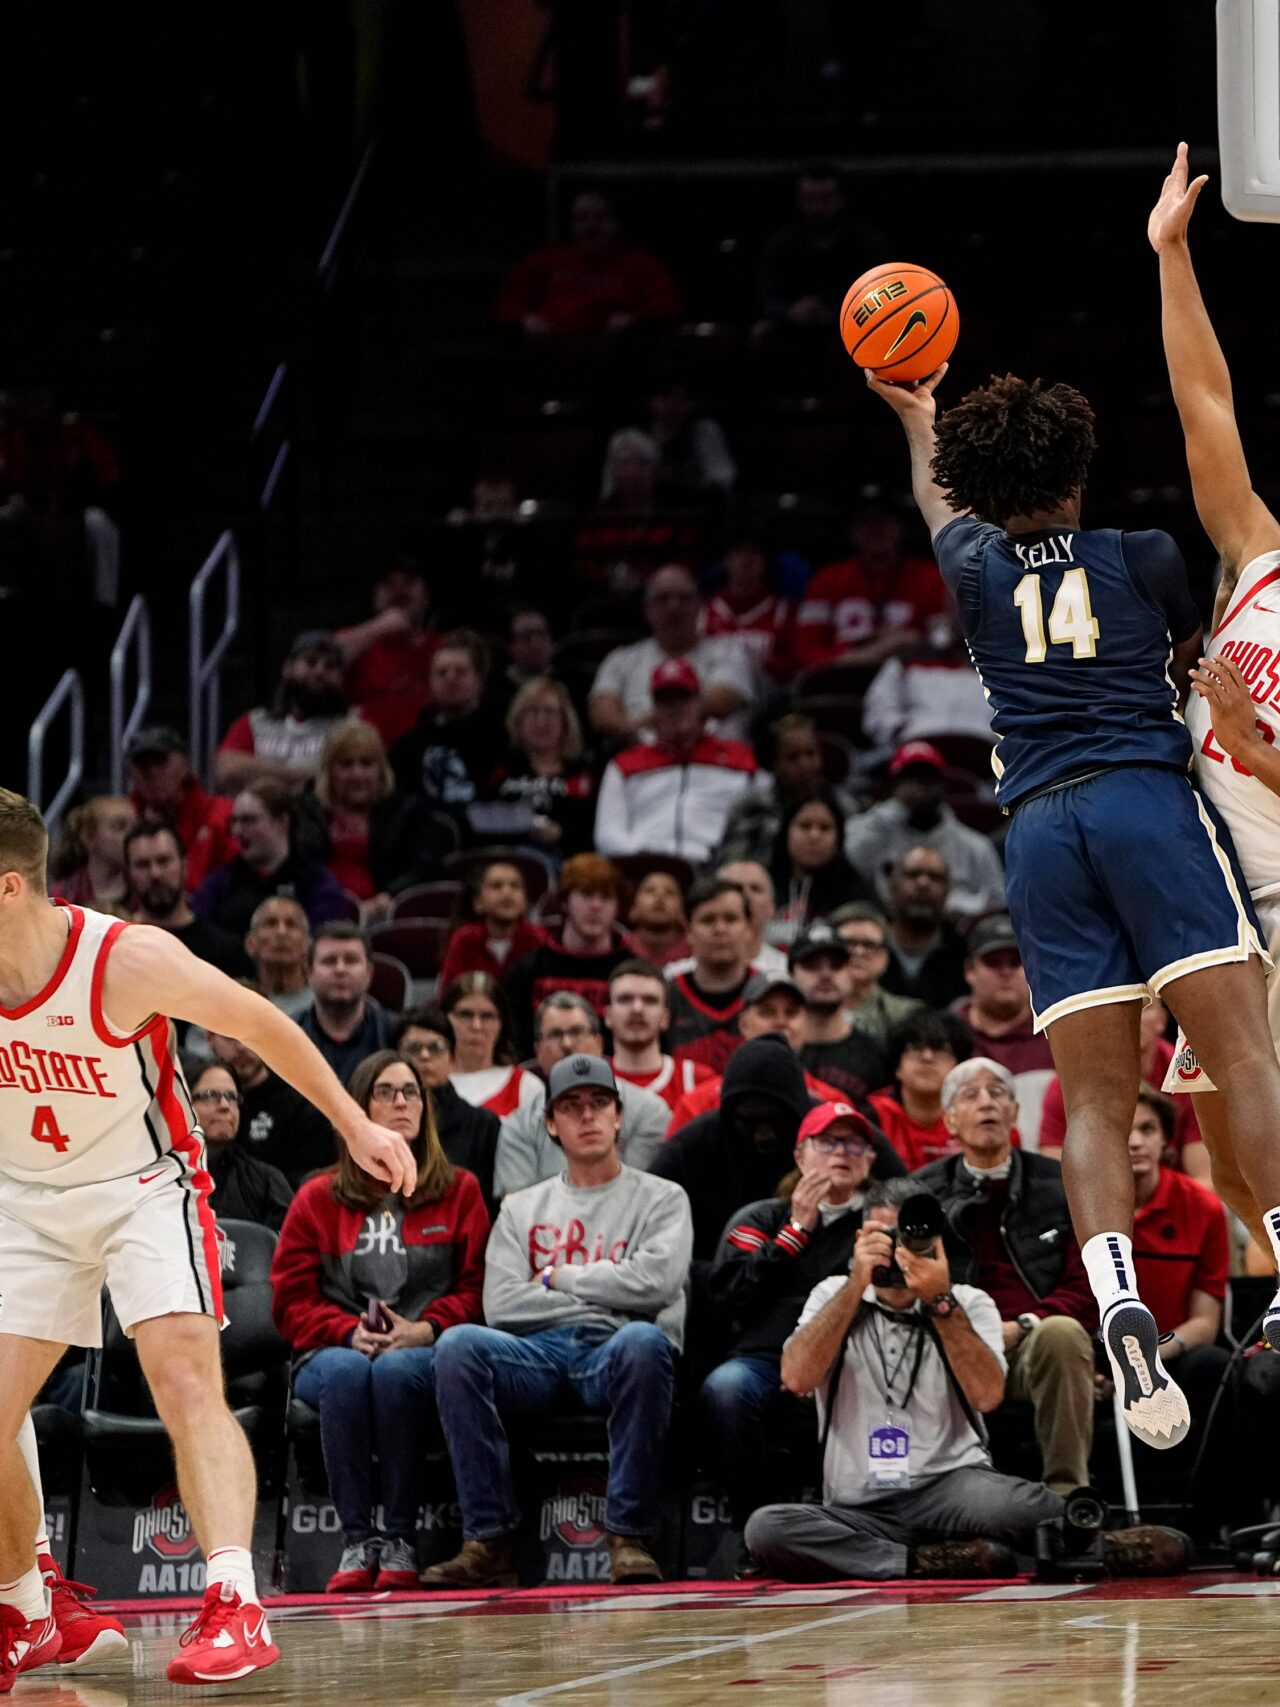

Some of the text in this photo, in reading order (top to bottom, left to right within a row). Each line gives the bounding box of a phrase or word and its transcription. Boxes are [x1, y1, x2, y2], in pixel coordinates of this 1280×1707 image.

[852, 280, 909, 329] ELITE
[1015, 533, 1075, 570] KELLY
[1013, 566, 1101, 663] 14
[30, 1104, 71, 1153] 4
[291, 1504, 343, 1533] GO
[138, 1562, 207, 1593] AA10
[546, 1551, 612, 1580] AA12
